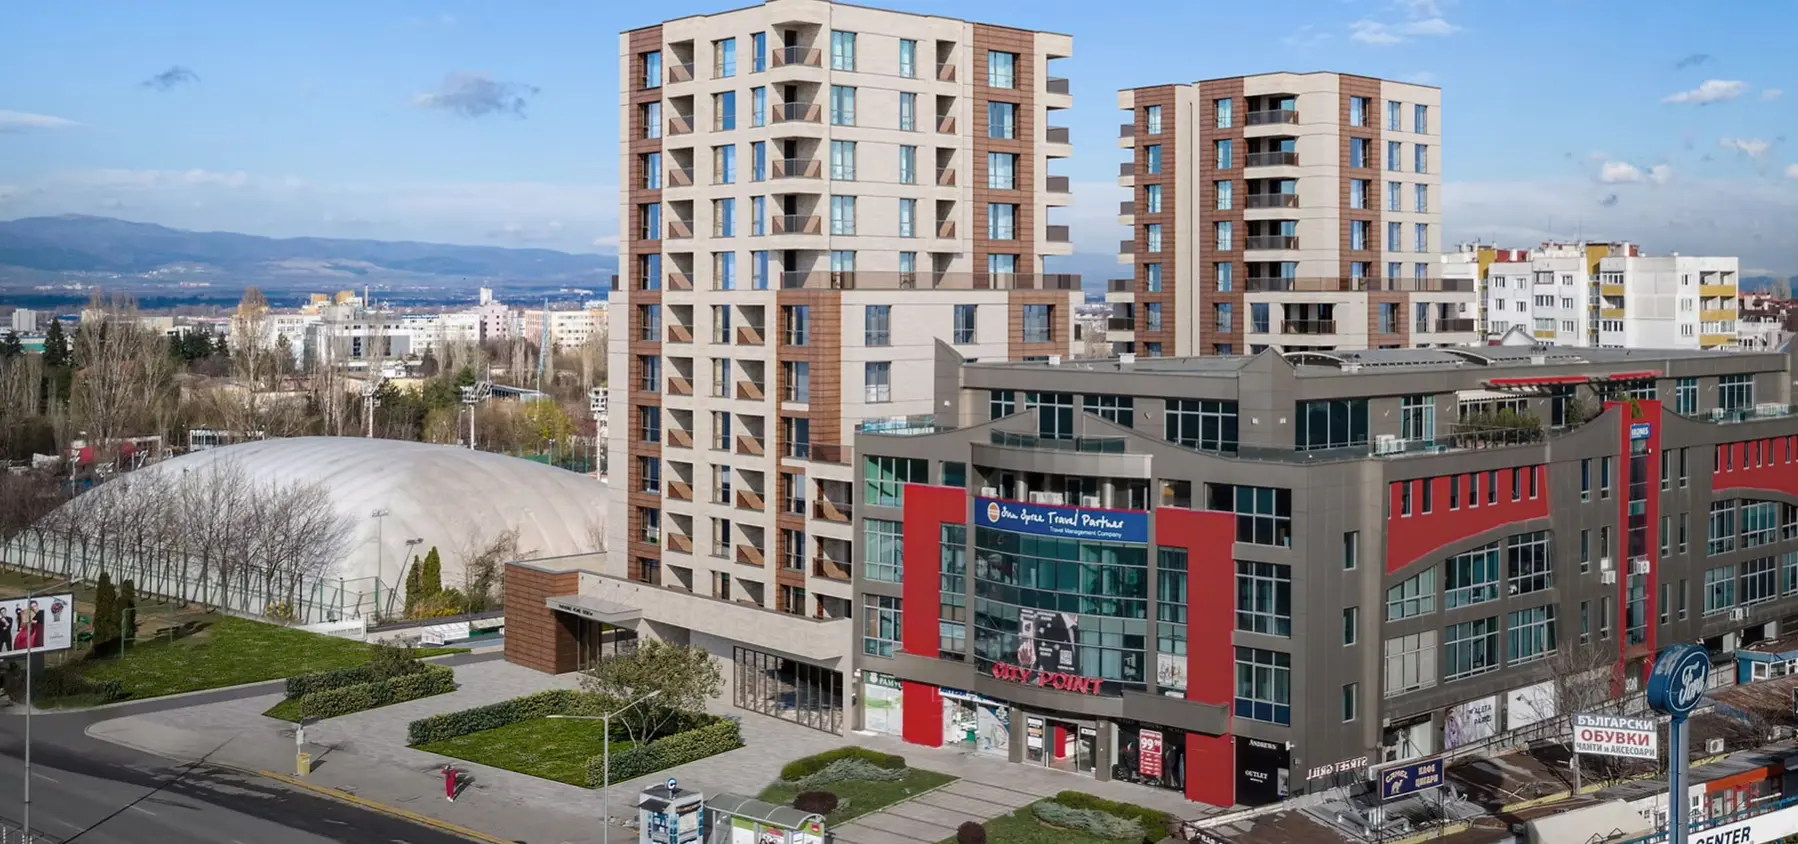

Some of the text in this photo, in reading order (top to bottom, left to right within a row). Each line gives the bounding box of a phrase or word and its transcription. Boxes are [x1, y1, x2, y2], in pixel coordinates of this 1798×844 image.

[1001, 506, 1124, 529] Sun Spree Travel Partner
[1065, 528, 1096, 537] Management
[1097, 530, 1122, 539] Company
[992, 661, 1104, 696] CITY POINT
[1678, 661, 1706, 706] Ford
[1577, 715, 1653, 731] БЪЛГАРСКИ
[1581, 729, 1650, 746] ОБУВКИ
[1576, 742, 1602, 751] ЧАНТИ
[1610, 745, 1655, 756] АКСЕСОАРИ
[1244, 769, 1268, 780] OUTLET
